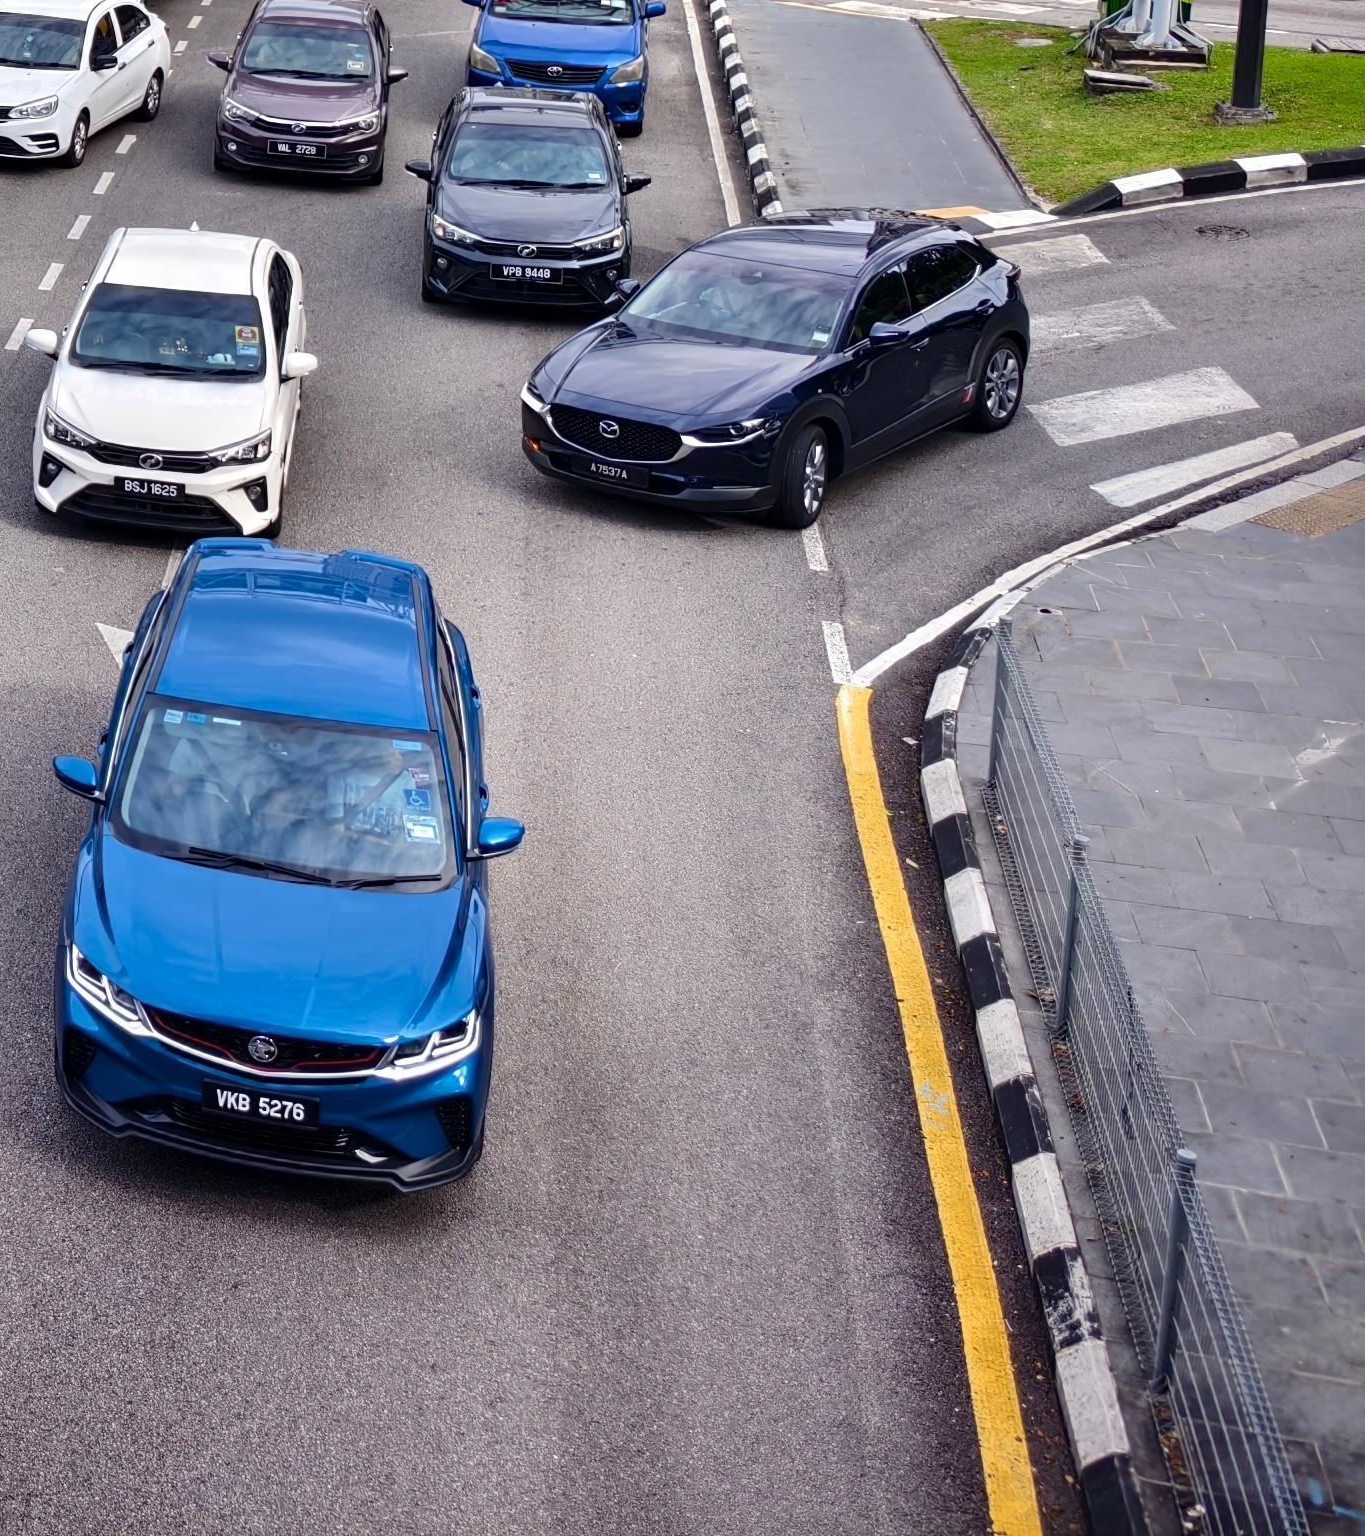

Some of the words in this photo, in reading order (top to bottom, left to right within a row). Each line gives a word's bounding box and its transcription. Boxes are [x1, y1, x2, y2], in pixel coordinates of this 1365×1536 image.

[503, 266, 522, 277] VPB
[124, 479, 148, 493] BSJ
[150, 483, 178, 497] 1625
[216, 1088, 251, 1113] VKB
[258, 1097, 305, 1121] 5276
